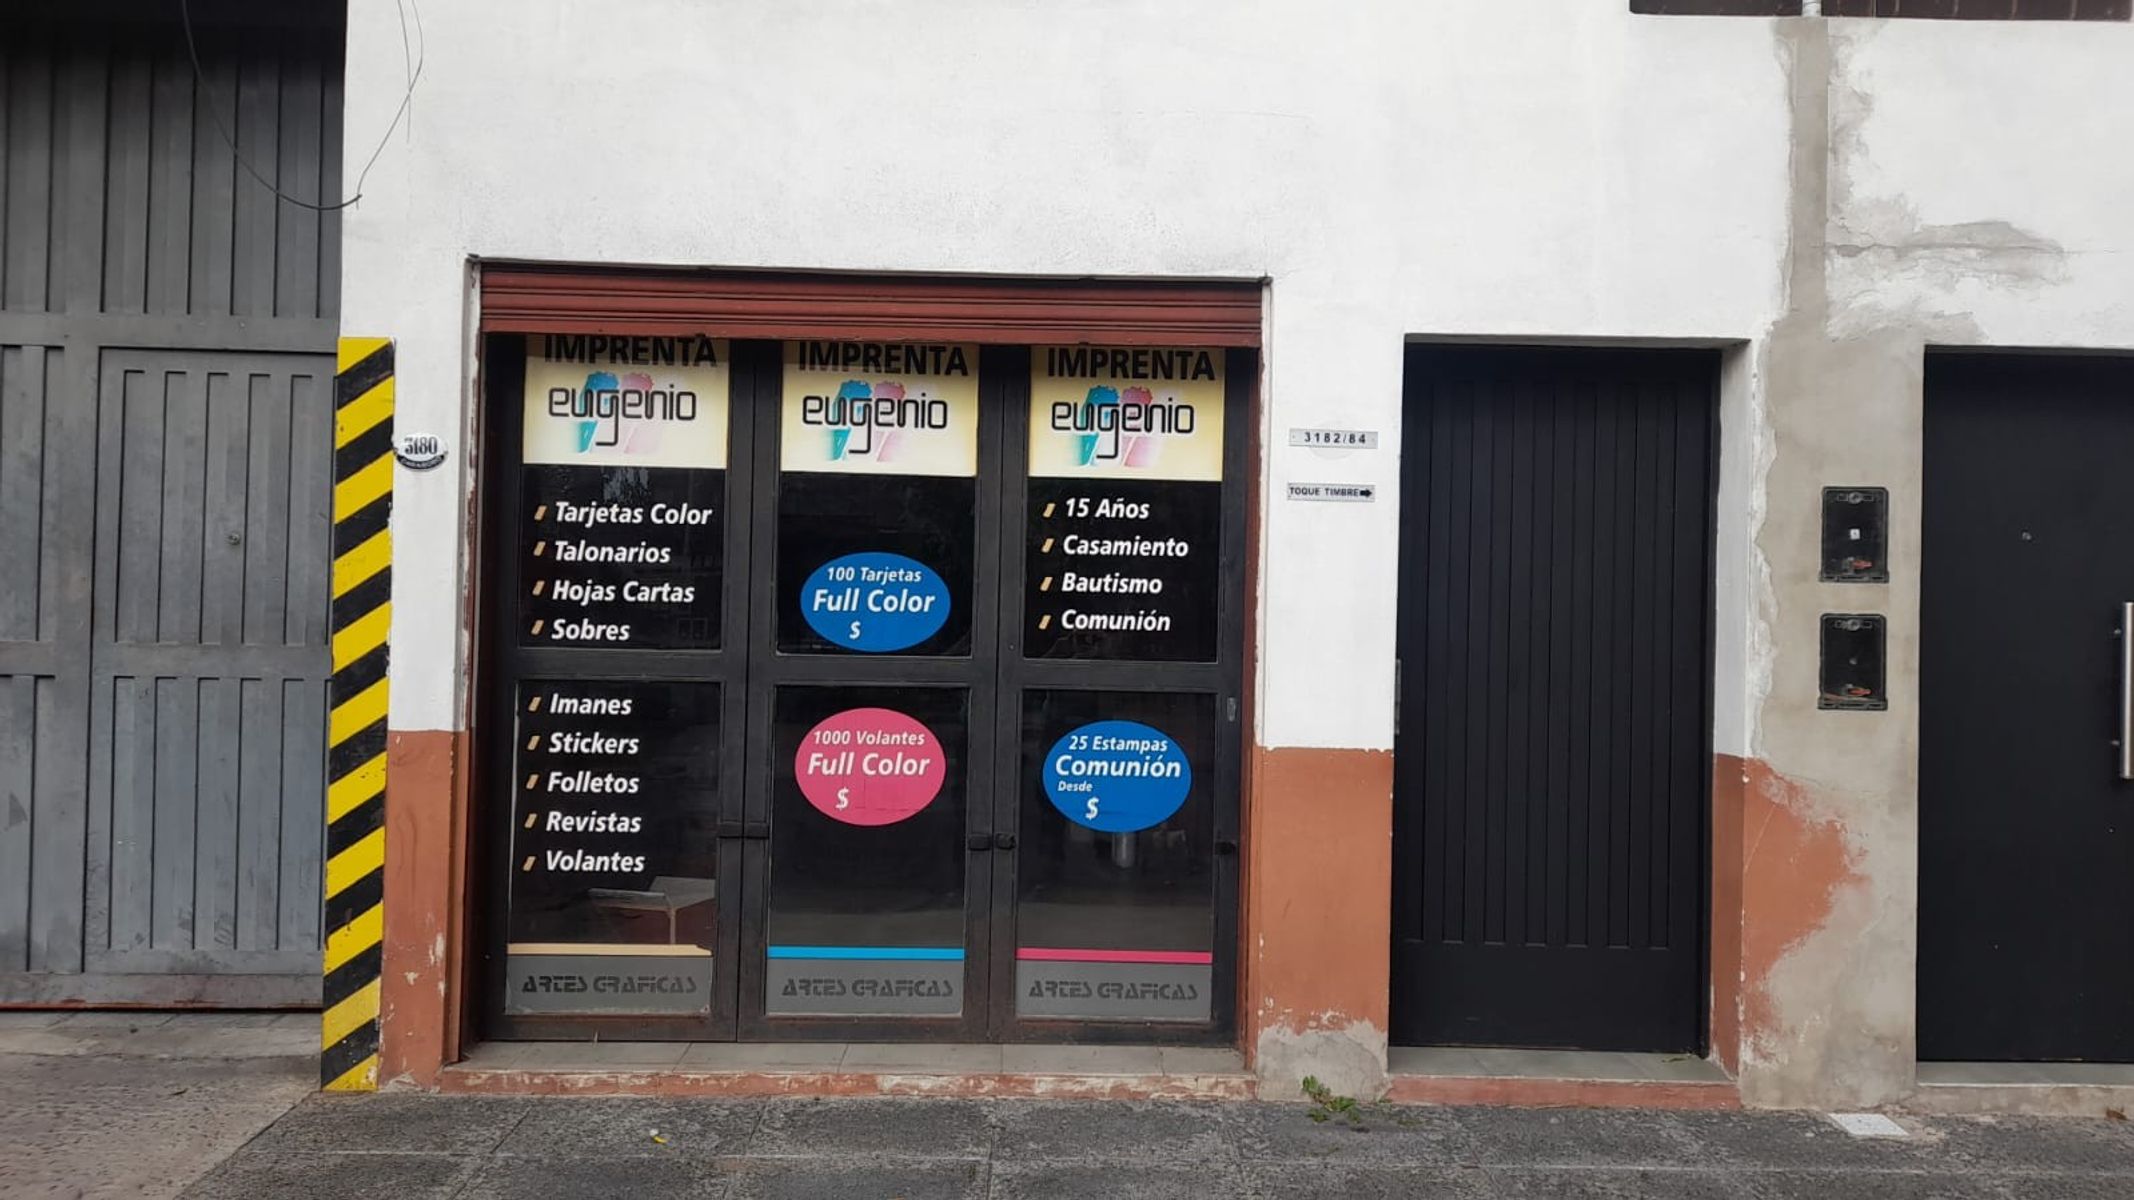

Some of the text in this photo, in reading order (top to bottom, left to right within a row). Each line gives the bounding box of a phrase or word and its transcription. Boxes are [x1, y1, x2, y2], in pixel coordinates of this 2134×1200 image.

[545, 334, 717, 366] IMPRENTA
[799, 341, 968, 376] IMPRENTA
[1048, 346, 1216, 381] IMPRENTA
[548, 384, 697, 446] eugenio
[802, 393, 948, 454] eugenio
[1051, 397, 1195, 459] eugenio
[1304, 431, 1366, 444] 3182/84
[404, 436, 438, 455] 3180
[1289, 486, 1359, 497] TOQUE TIMBRE
[555, 501, 712, 528] Tarjetas Color
[1065, 497, 1150, 519] 15 Años
[554, 540, 671, 564] Talonarios
[1063, 534, 1189, 557] Casamiento
[827, 567, 922, 586] 100 Tarjetas
[1061, 572, 1163, 594] Bautismo
[552, 579, 695, 606] Hojas Cartas
[813, 588, 936, 613] Full Color
[551, 618, 630, 641] Sobres
[849, 620, 861, 640] $
[1061, 608, 1171, 631] Comunión
[550, 693, 632, 716] Imanes
[548, 732, 639, 755] Stickers
[813, 730, 925, 746] 1000 Volantes
[1068, 735, 1168, 754] 25 Estampas
[807, 752, 930, 776] Full Color
[1055, 754, 1181, 778] Comunión
[547, 771, 639, 794] Folletos
[1057, 780, 1093, 793] Desde
[835, 787, 849, 811] $
[1085, 796, 1100, 820] $
[546, 811, 642, 834] Revistas
[546, 850, 645, 873] Volantes
[521, 975, 697, 994] ARTES GRAFICAS
[782, 978, 953, 998] ARTES GRAFICAS
[1028, 980, 1199, 1001] ARTES GRAFICAS
